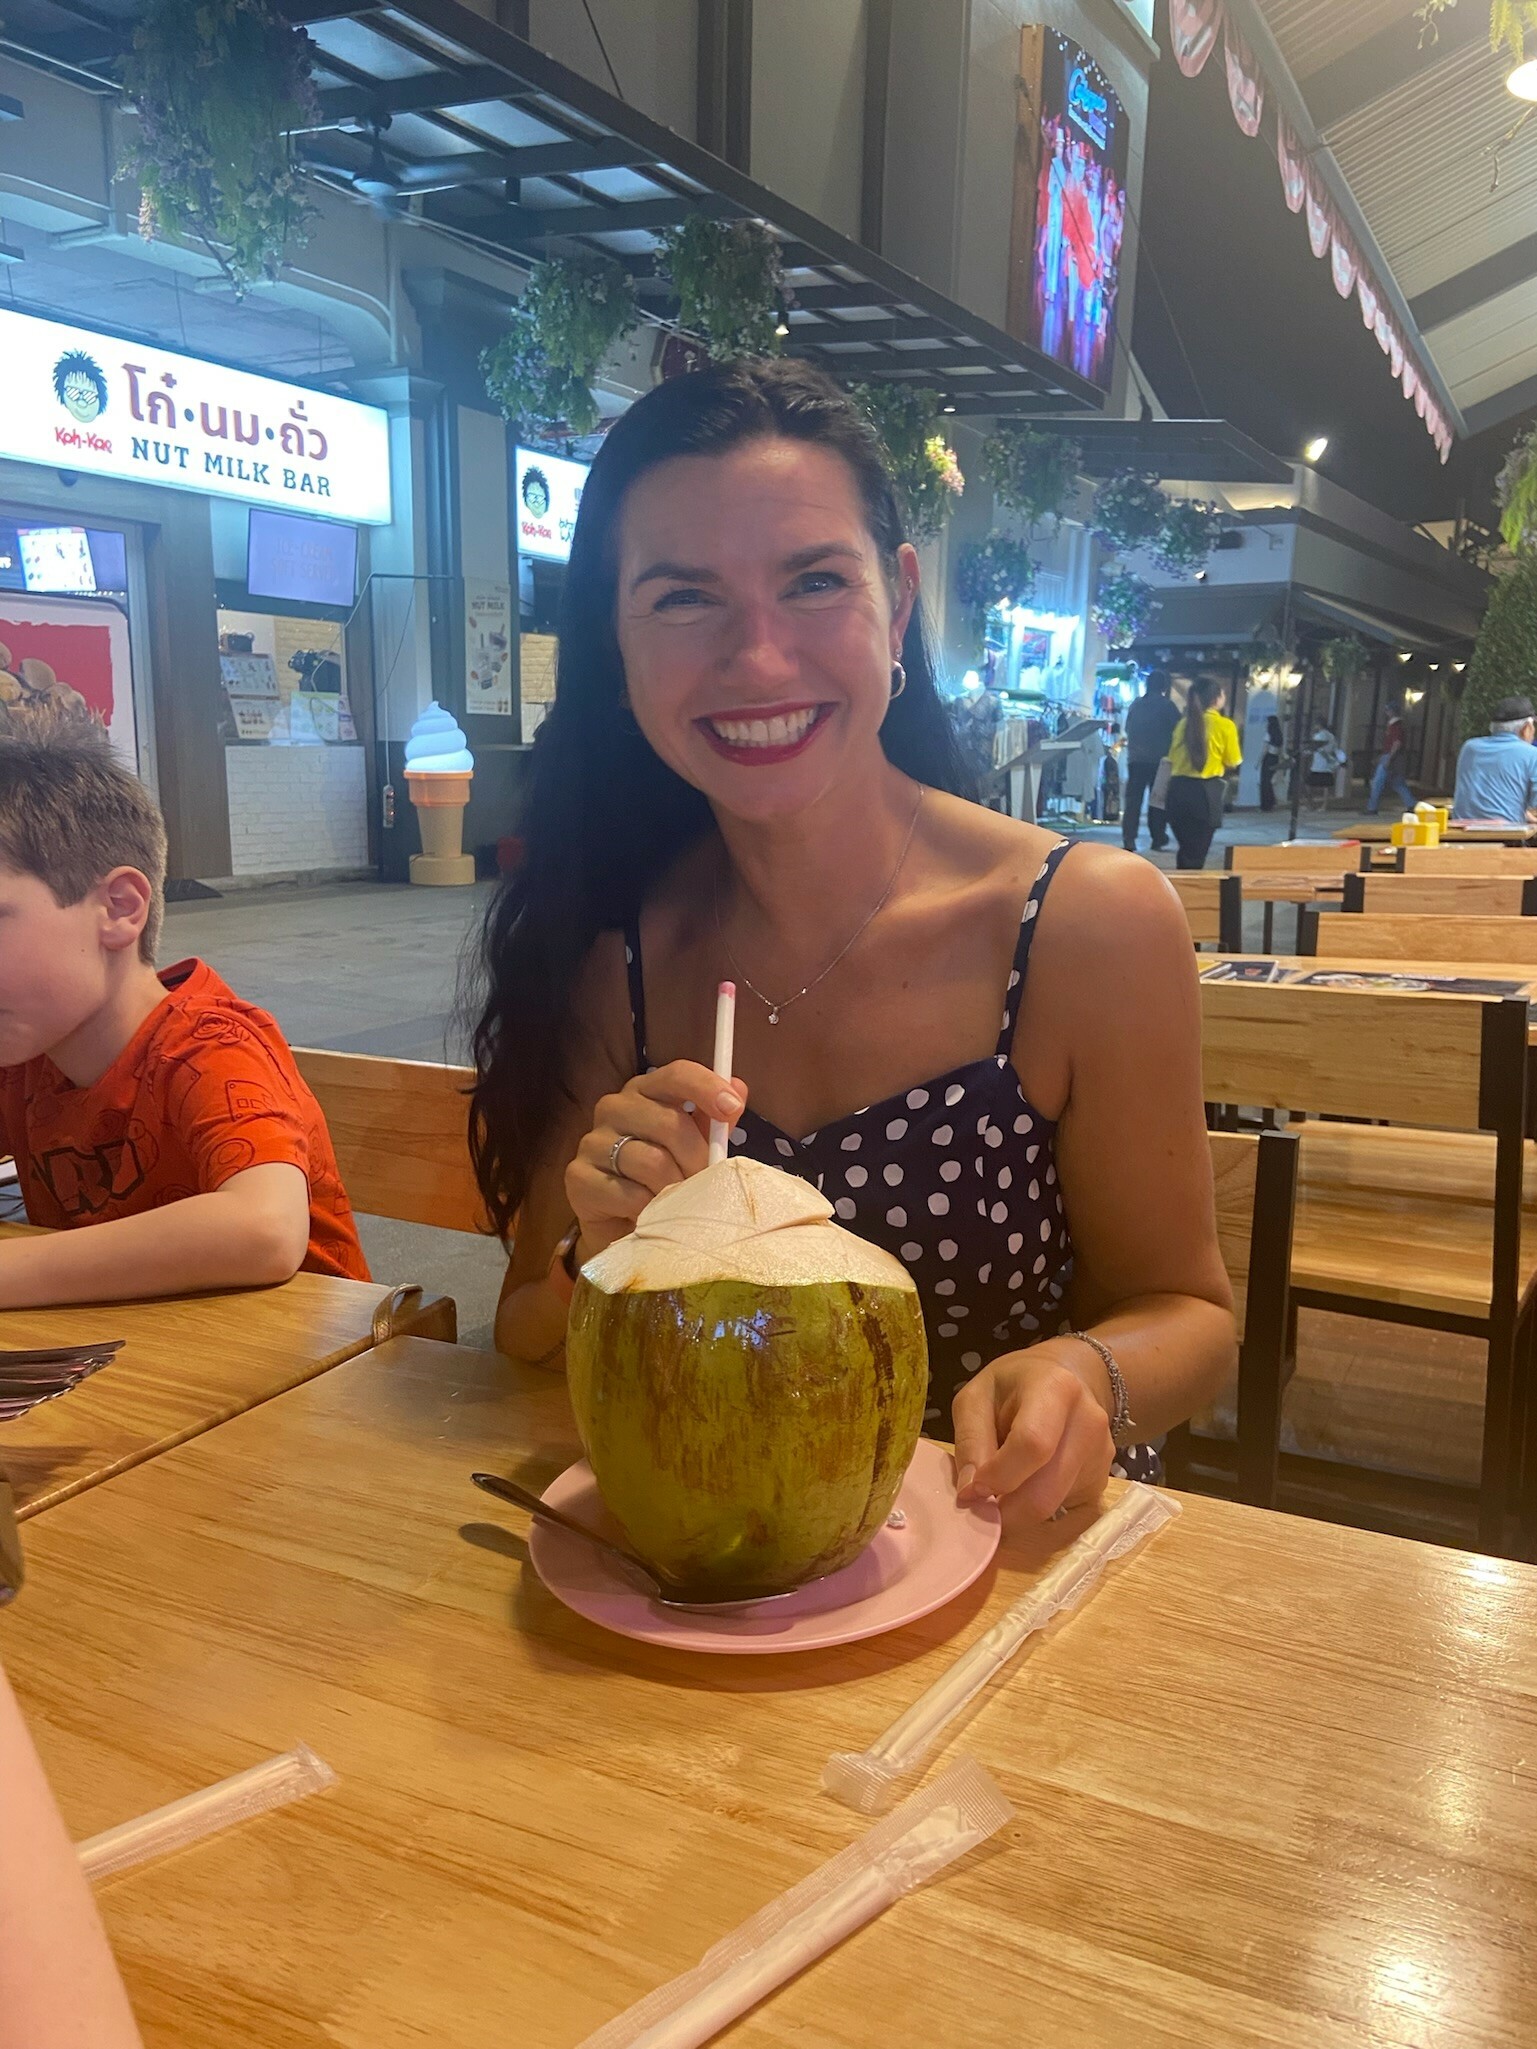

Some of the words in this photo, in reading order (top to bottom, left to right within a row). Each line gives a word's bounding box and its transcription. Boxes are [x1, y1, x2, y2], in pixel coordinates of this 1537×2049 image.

[131, 437, 189, 469] NUT
[204, 452, 271, 485] MILK
[282, 468, 331, 497] BAR
